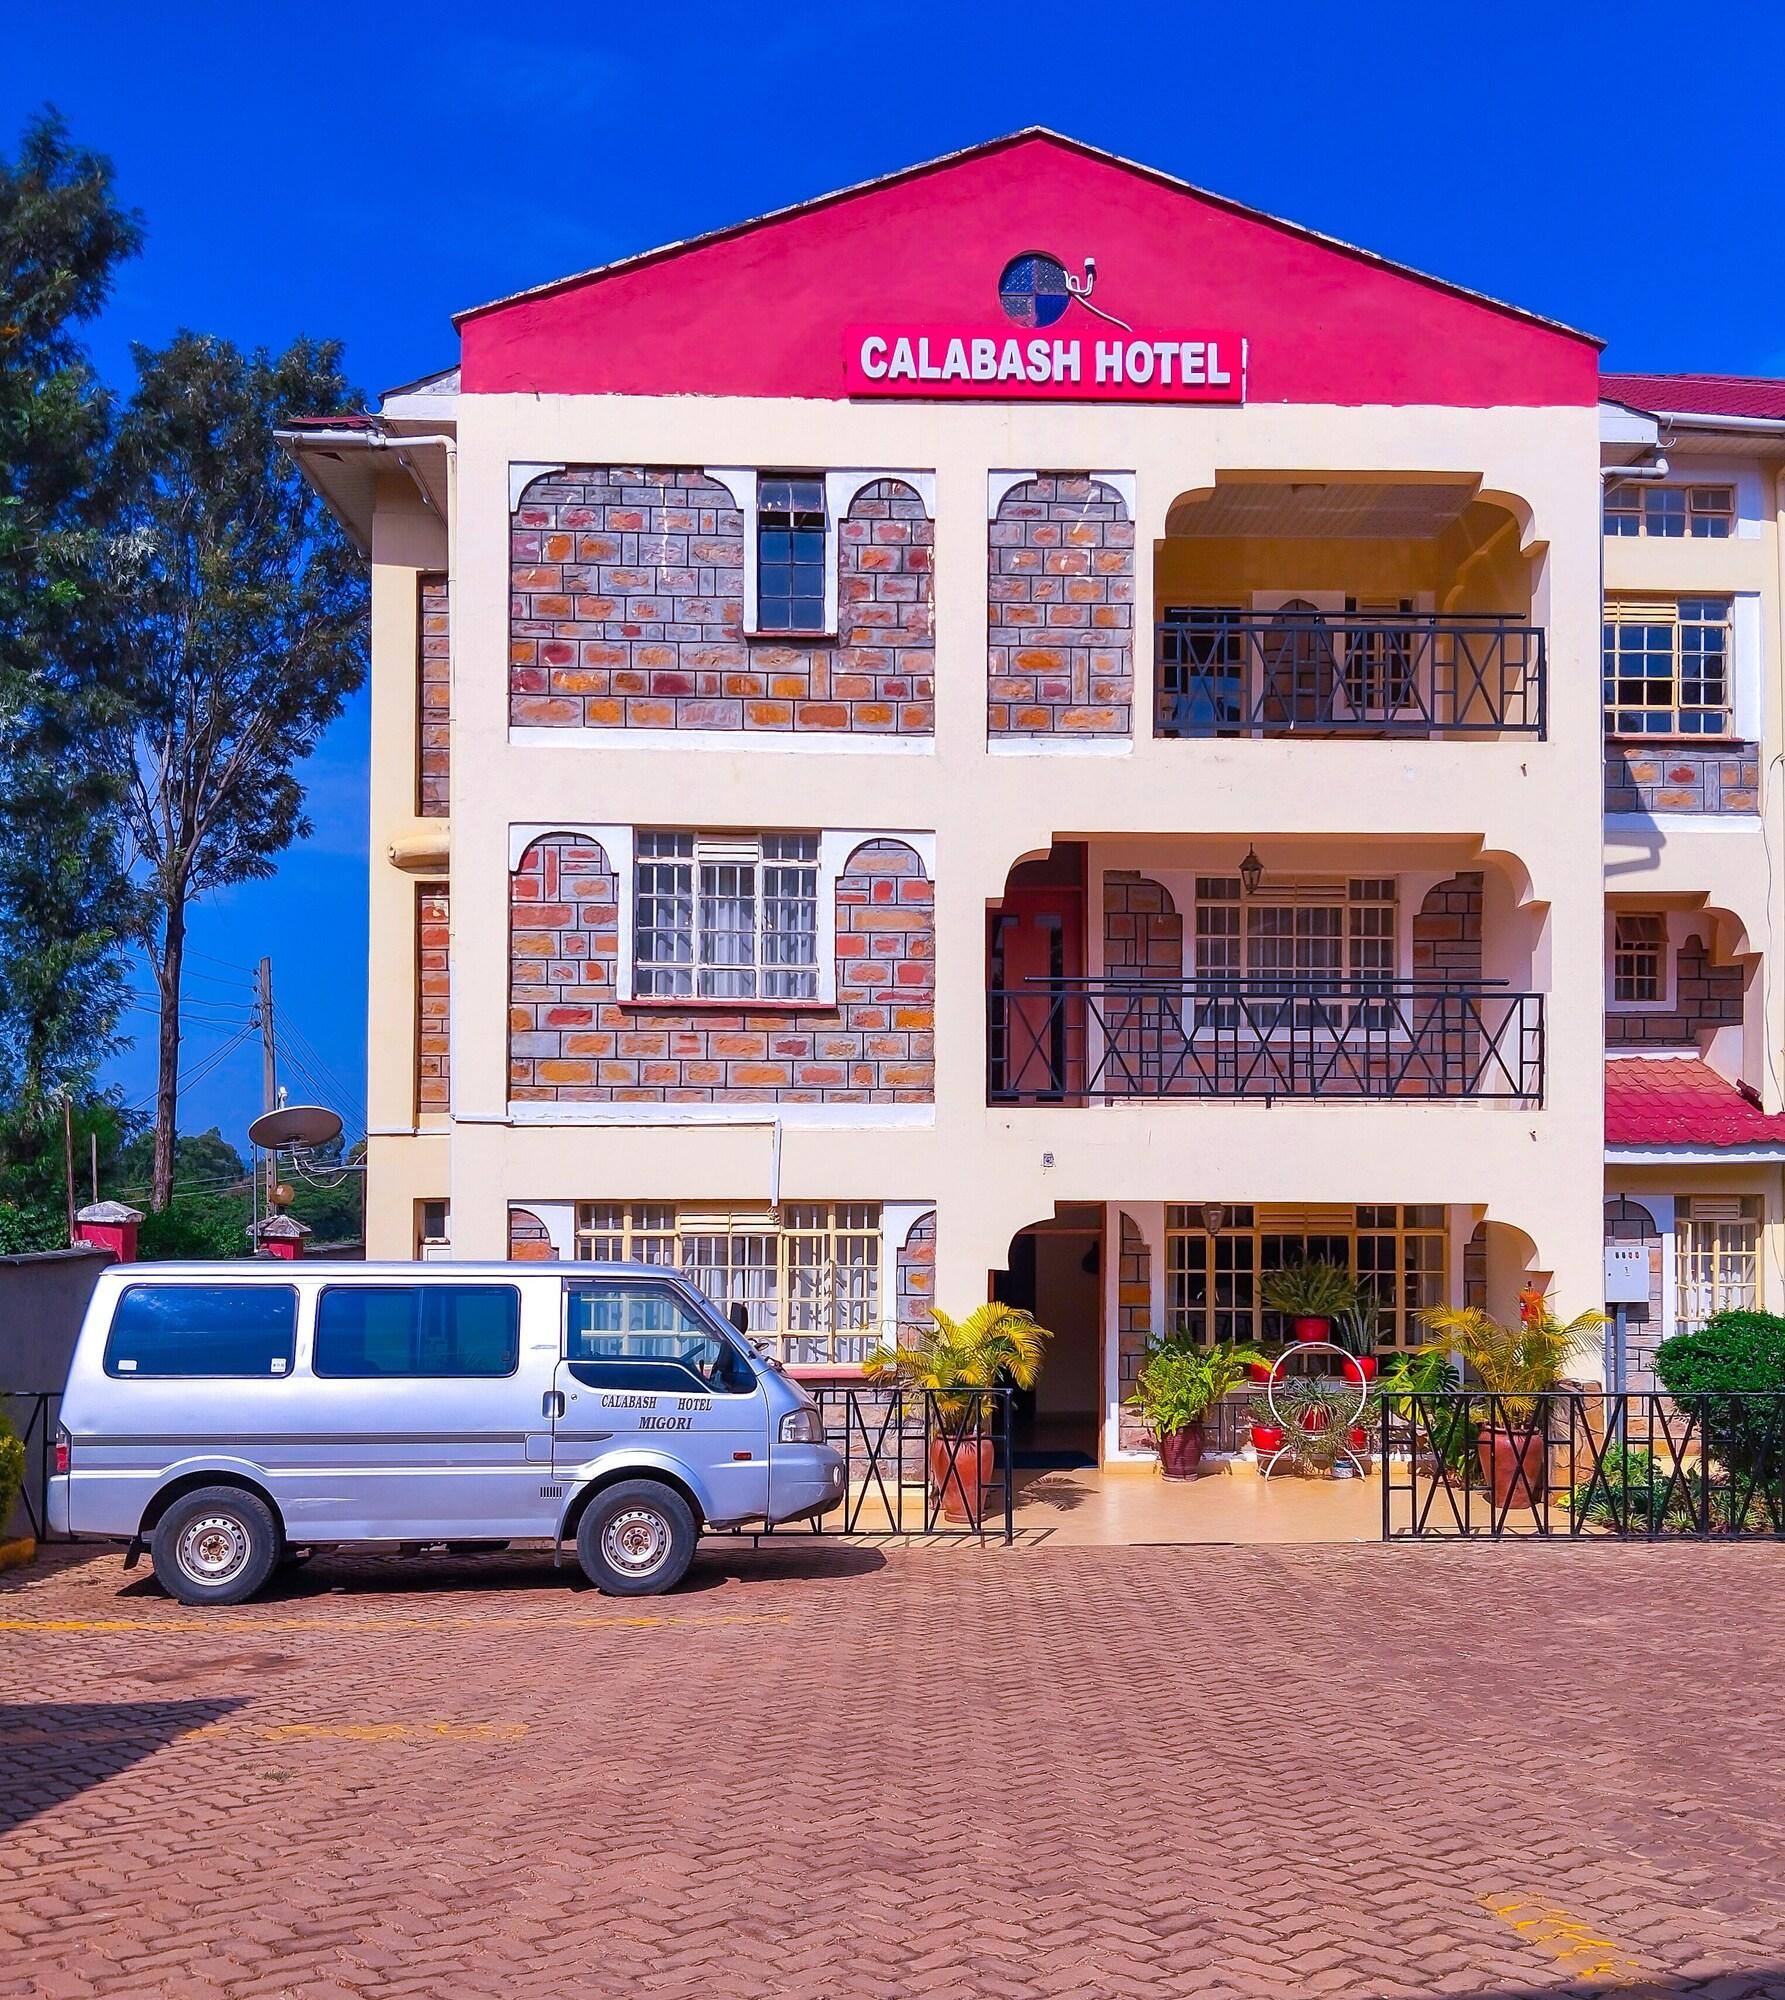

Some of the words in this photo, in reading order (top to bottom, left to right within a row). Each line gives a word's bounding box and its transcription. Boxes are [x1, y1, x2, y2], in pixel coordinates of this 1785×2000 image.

[860, 336, 1080, 382] CALABASH
[1095, 340, 1231, 384] HOTEL
[601, 1395, 657, 1409] CALABASH
[677, 1398, 712, 1411] HOTEL
[639, 1416, 693, 1430] MIGORI
